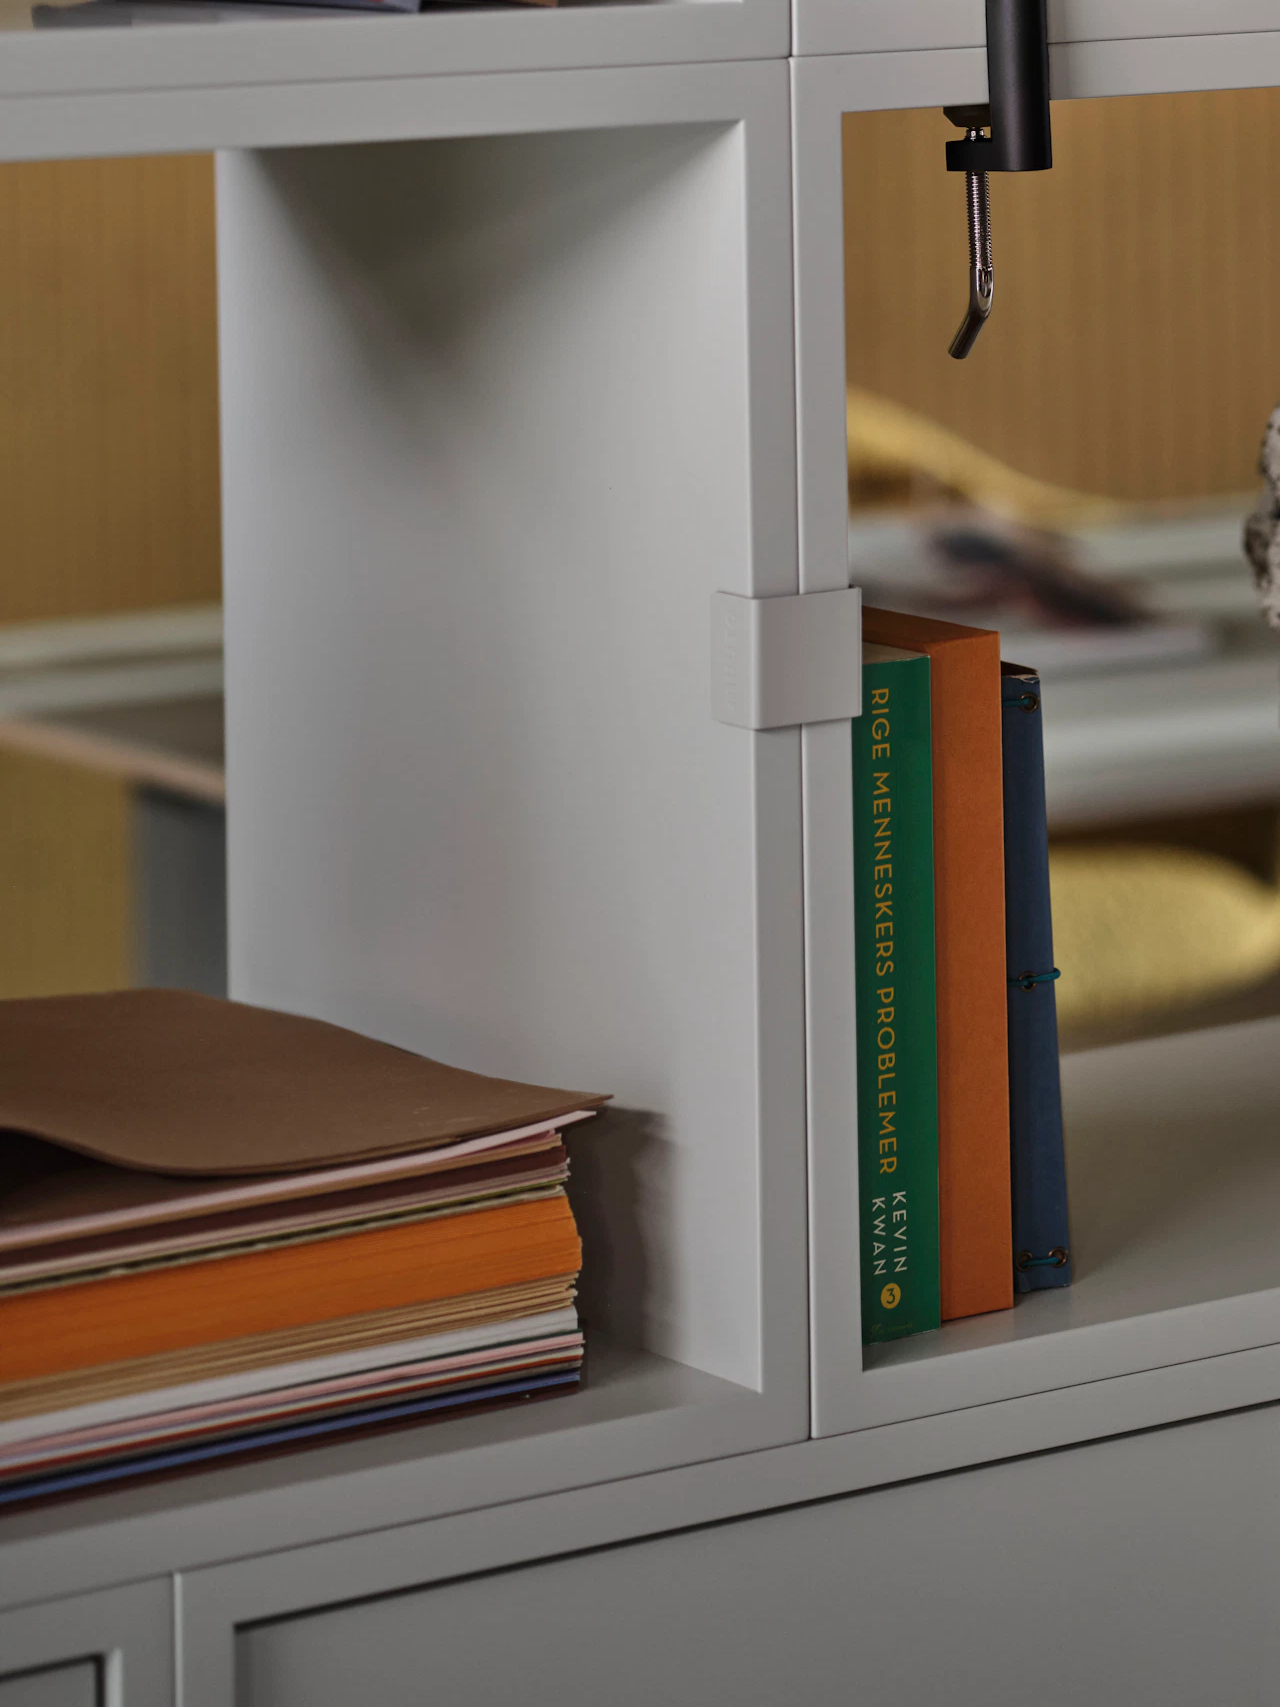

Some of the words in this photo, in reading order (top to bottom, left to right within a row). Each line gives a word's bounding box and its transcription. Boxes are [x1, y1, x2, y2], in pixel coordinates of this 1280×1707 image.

[871, 688, 890, 760] RIGE
[873, 772, 894, 977] MENNESKERS
[876, 987, 897, 1174] PROBLEMER
[872, 1197, 887, 1275] KWAN
[892, 1191, 908, 1272] KEVIN
[886, 1287, 896, 1305] 3
